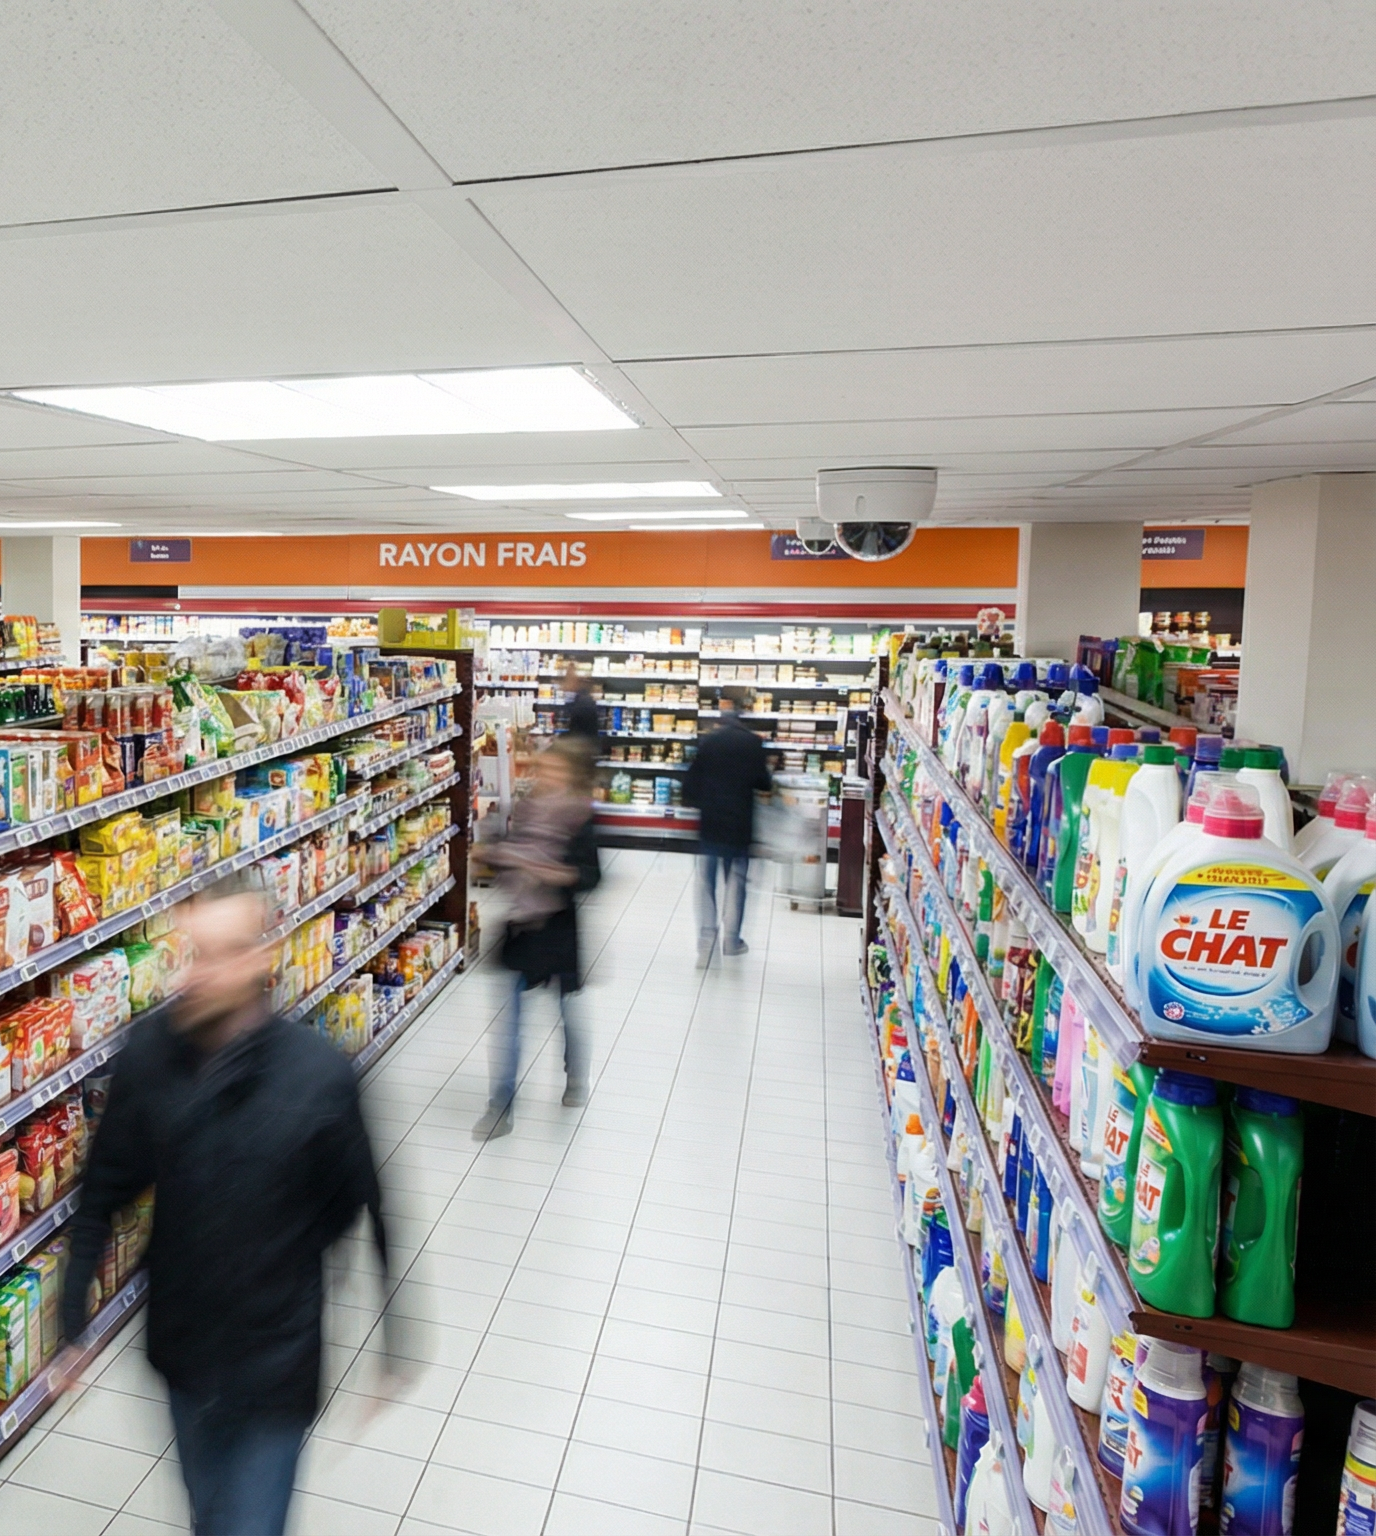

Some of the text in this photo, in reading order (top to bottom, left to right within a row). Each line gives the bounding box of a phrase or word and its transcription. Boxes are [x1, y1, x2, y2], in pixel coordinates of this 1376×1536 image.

[379, 541, 587, 567] RAYON FRAIS
[1208, 908, 1250, 931] LE
[1160, 929, 1288, 969] CHAT
